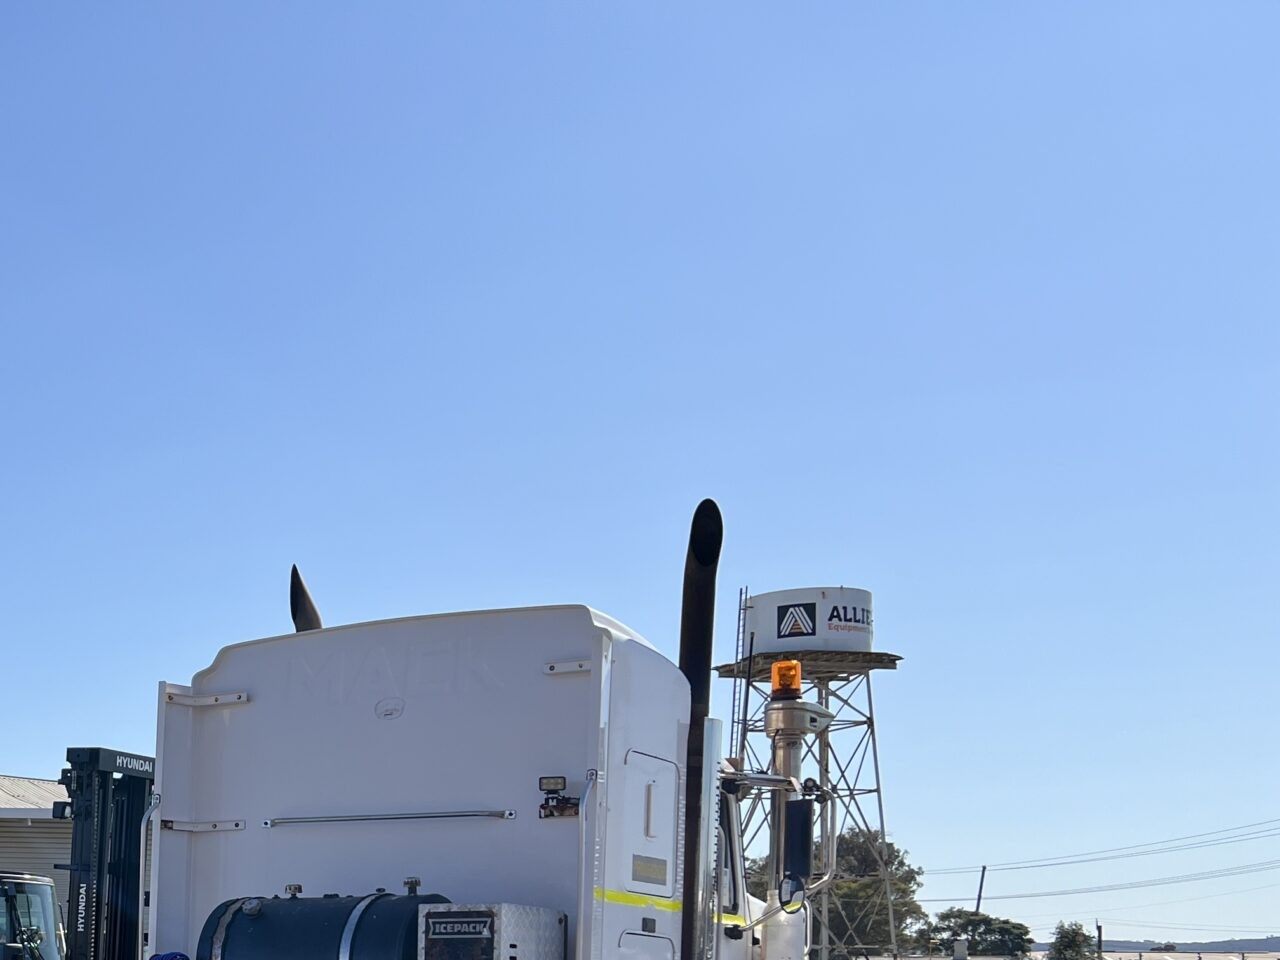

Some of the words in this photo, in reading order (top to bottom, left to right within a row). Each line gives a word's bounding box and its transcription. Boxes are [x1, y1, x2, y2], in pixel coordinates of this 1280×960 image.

[827, 605, 873, 626] ALLIE
[116, 755, 153, 773] HYUNDAI
[77, 883, 87, 932] HYUNDAI
[435, 923, 486, 933] ICEPACK
